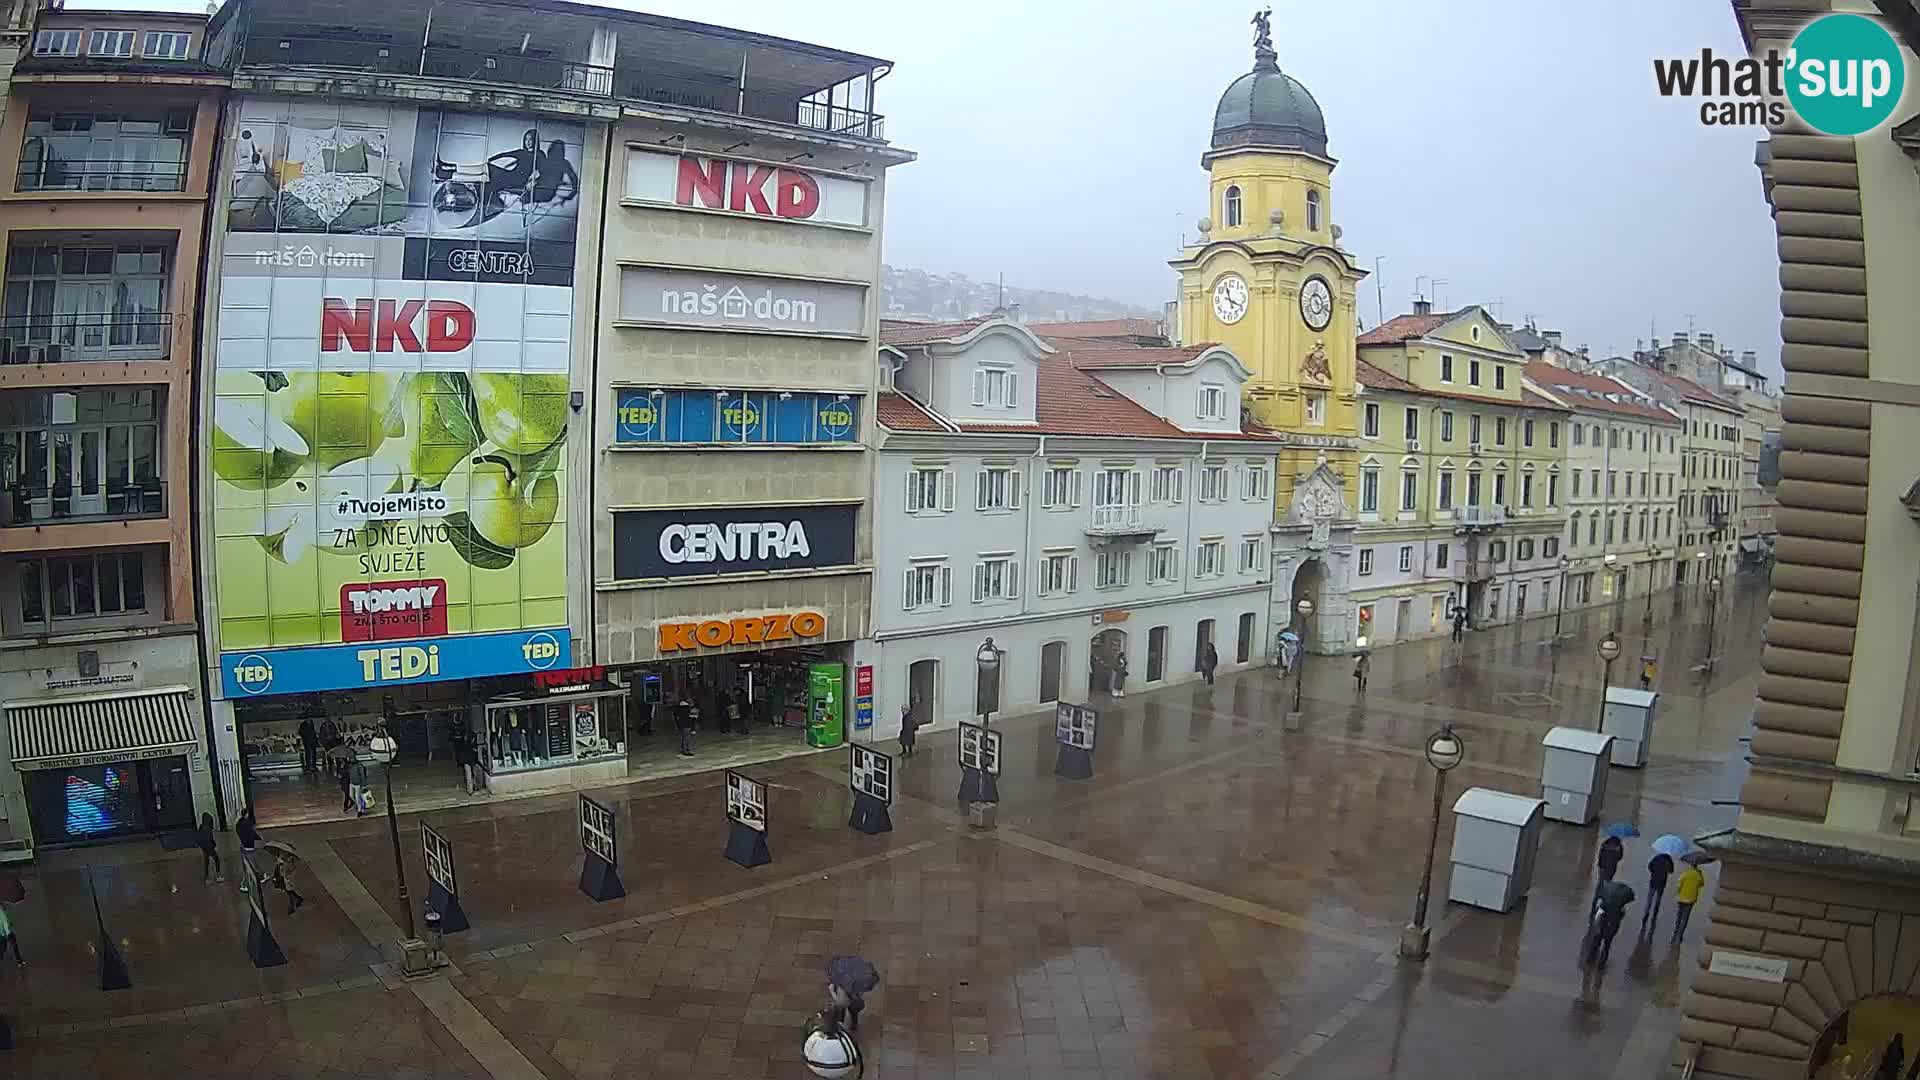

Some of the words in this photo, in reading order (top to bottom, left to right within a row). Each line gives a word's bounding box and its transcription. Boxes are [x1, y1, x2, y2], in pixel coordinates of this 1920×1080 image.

[676, 157, 821, 219] NKD
[255, 244, 296, 267] naš
[319, 245, 366, 268] dom
[447, 248, 535, 275] CENTRA
[661, 284, 718, 316] naš
[753, 288, 817, 323] dom
[321, 297, 478, 353] NKD
[617, 407, 658, 423] TEDi
[723, 408, 760, 426] TEDi
[819, 410, 853, 427] TEDi
[337, 496, 446, 516] #TvojeMisto
[333, 528, 358, 548] ZA
[366, 524, 450, 547] DNEVNO
[659, 520, 811, 563] CENTRA
[359, 547, 426, 574] SVJEŽE
[348, 585, 439, 614] TOMMY
[658, 611, 826, 653] KORZO
[357, 645, 440, 682] TEDi
[522, 643, 561, 660] TEDi
[233, 664, 273, 684] TEDi
